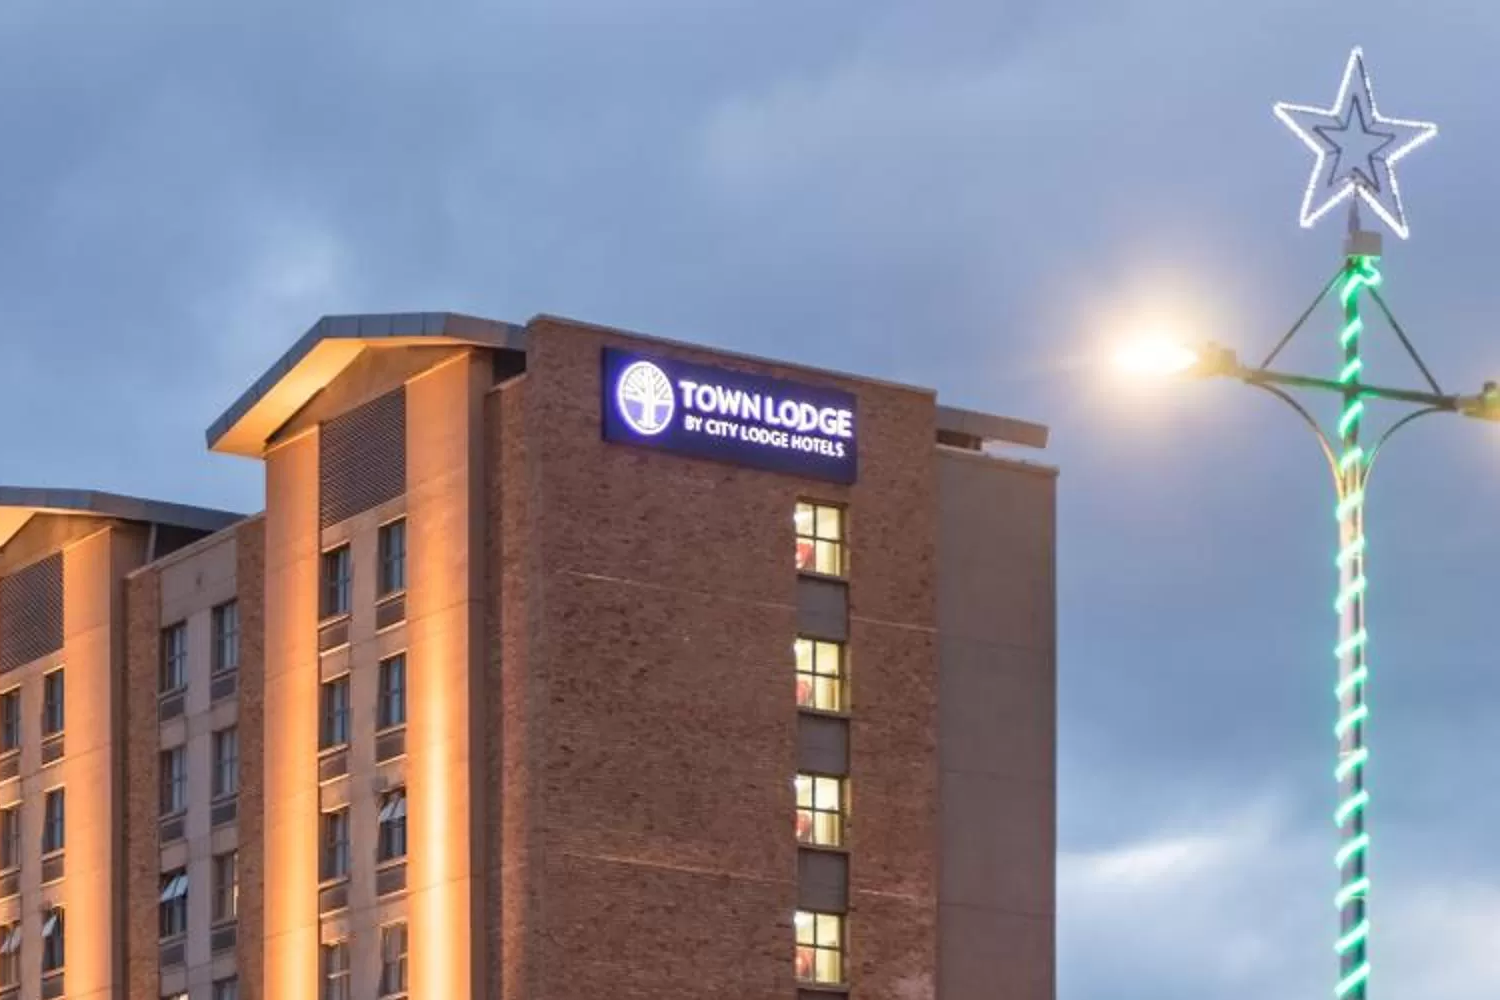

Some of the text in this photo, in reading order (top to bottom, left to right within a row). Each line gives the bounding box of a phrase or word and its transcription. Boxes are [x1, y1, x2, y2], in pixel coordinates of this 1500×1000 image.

[678, 380, 853, 438] TOWN LODGE
[684, 415, 845, 458] BY CITY LODGE HOTELS
